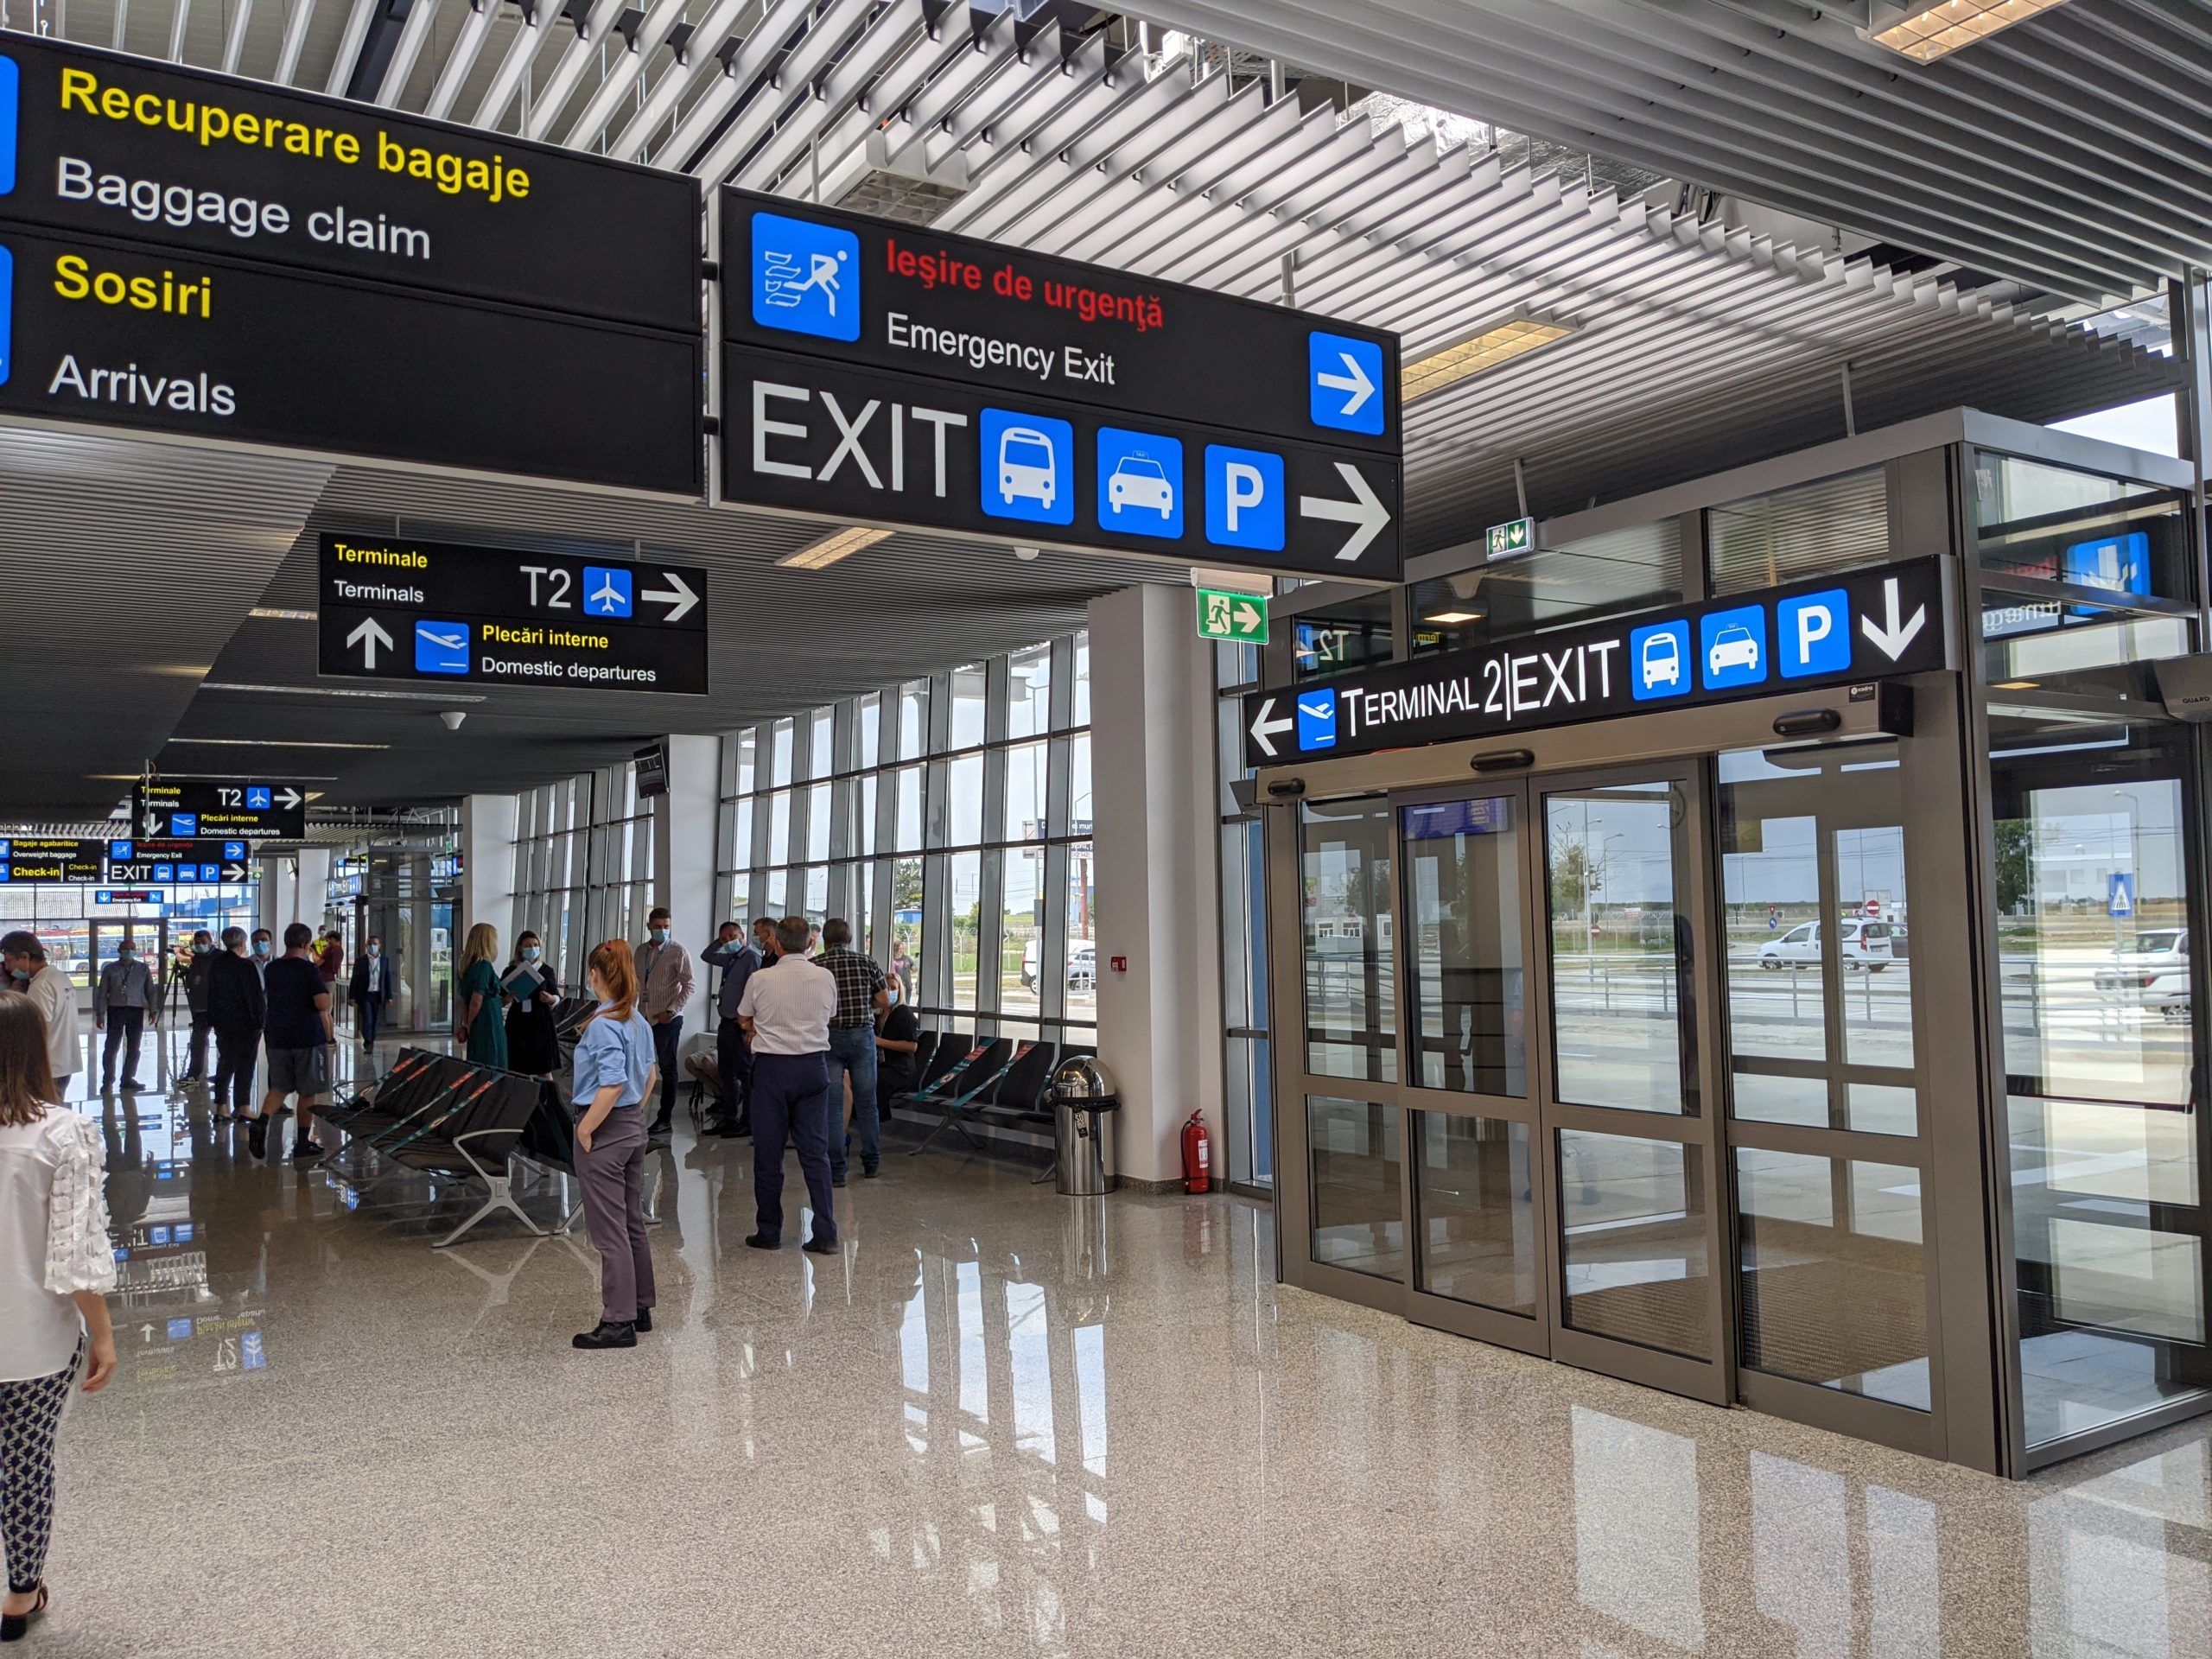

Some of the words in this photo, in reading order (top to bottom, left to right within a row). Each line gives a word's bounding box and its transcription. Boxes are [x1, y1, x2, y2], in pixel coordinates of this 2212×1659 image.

[60, 67, 360, 164] Recuperare
[378, 130, 531, 203] bagaje
[57, 156, 290, 238] Baggage
[308, 206, 430, 259] claim
[54, 255, 212, 318] Sosiri
[993, 264, 1033, 301] de
[887, 311, 1055, 380] Emergency
[1065, 346, 1116, 385] Exit
[48, 354, 236, 416] Arrivals
[753, 380, 968, 498] EXIT
[1226, 461, 1264, 532] P
[334, 543, 428, 569] Terminale
[519, 565, 571, 608] T2
[334, 580, 424, 603] Terminals
[483, 624, 543, 645] Plecări
[549, 629, 609, 649] interne
[1797, 605, 1832, 664] P
[482, 656, 563, 677] Domestic
[567, 662, 657, 682] departures
[140, 799, 180, 808] Trminals
[141, 786, 181, 795] Trminale
[218, 789, 242, 806] T2
[13, 868, 60, 876] Check-in
[111, 865, 151, 880] EXIT
